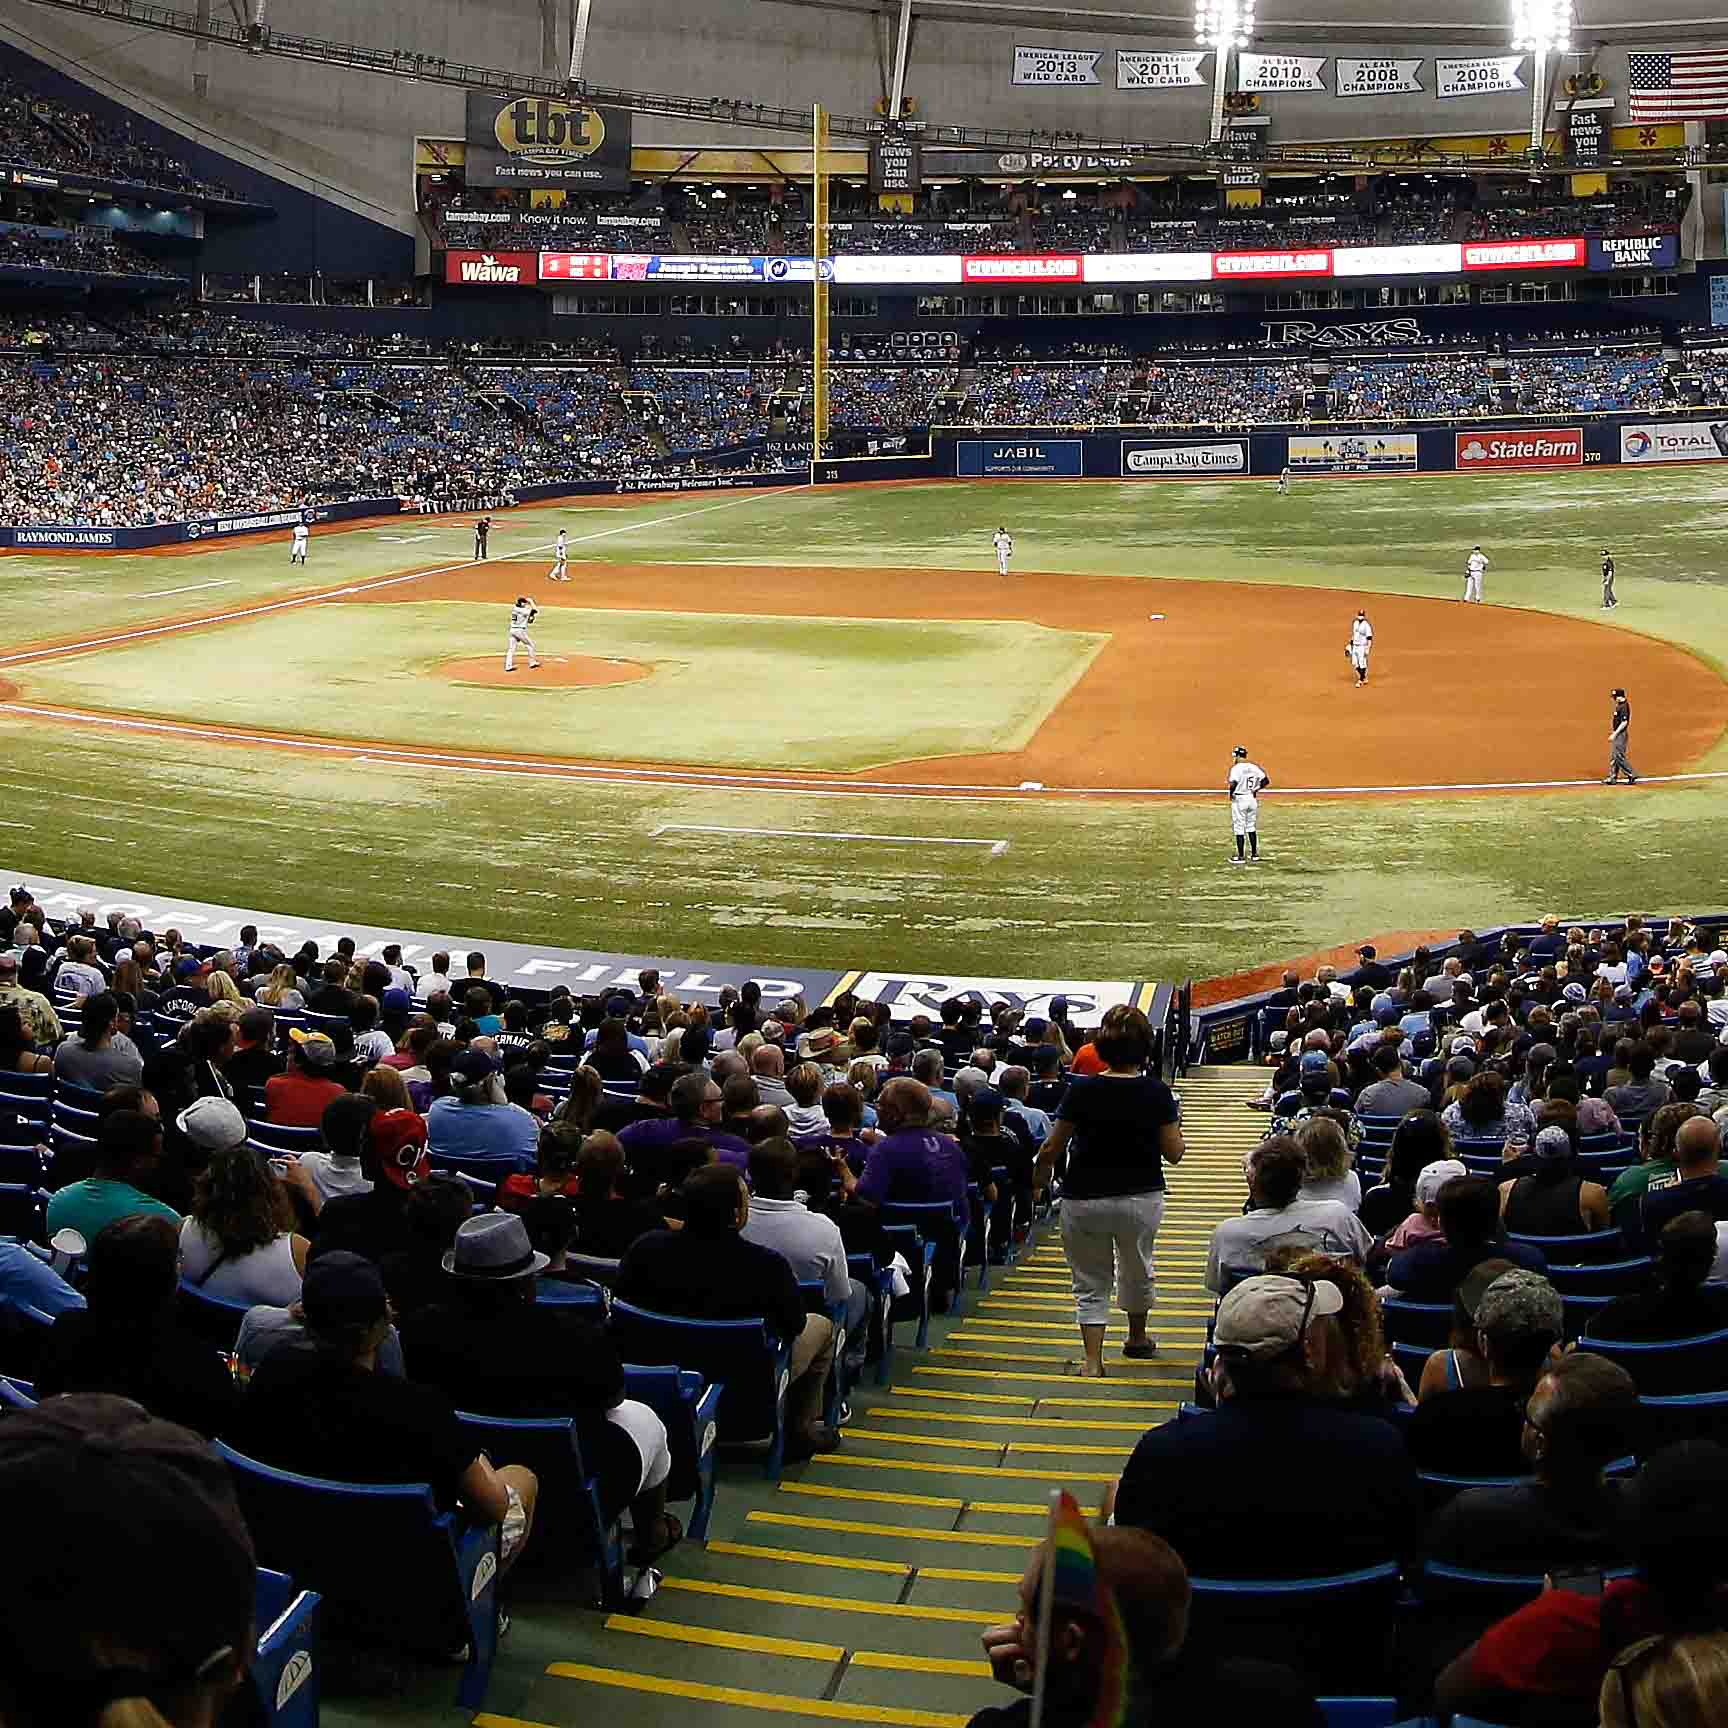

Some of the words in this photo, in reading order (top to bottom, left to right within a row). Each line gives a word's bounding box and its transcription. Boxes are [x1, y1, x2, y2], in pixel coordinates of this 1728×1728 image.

[1036, 60, 1077, 72] 2013
[1140, 63, 1180, 76] 2011
[1023, 72, 1053, 81] WILD
[1056, 74, 1087, 82] CARD
[1259, 66, 1301, 79] 2010
[1356, 69, 1399, 82] 2008
[1456, 68, 1500, 82] 2008
[1127, 76, 1154, 84] WILD
[1160, 75, 1191, 84] CARD
[1245, 79, 1313, 88] CHAMPIONS
[1343, 82, 1410, 92] CHAMPIONS
[1443, 81, 1512, 92] CHAMPIONS
[511, 100, 591, 145] tbt
[1571, 113, 1597, 125] Fast
[1227, 131, 1257, 141] Have
[1570, 125, 1602, 136] news
[1575, 136, 1597, 148] you
[880, 147, 912, 156] news
[885, 158, 907, 169] you
[495, 166, 515, 176] Fast
[518, 168, 542, 177] news
[545, 169, 562, 178] you
[564, 170, 581, 178] can
[584, 171, 602, 179] use.
[885, 167, 907, 177] can
[884, 179, 909, 188] use.
[1223, 173, 1260, 184] buzz?
[446, 211, 510, 223] tampabay.com
[520, 213, 551, 224] Know
[553, 213, 561, 224] it
[564, 215, 588, 225] now.
[597, 215, 660, 227] tampabay.com
[1602, 237, 1662, 251] REPUBLIC
[1614, 249, 1651, 263] BANK
[461, 261, 520, 281] Wawa
[1260, 318, 1420, 347] RAYS
[766, 442, 780, 451] 162
[784, 441, 833, 451] LANDNG
[1655, 434, 1711, 449] TOTAL
[993, 447, 1046, 459] JABIL
[1584, 452, 1600, 462] 370
[1133, 455, 1173, 468] Tampa
[1176, 453, 1199, 468] Bay
[1201, 452, 1238, 465] Times
[625, 479, 636, 489] St.
[638, 479, 679, 490] Petersburg
[681, 478, 717, 488] Welcomes
[17, 532, 74, 544] RAYMOND
[75, 532, 112, 544] JAMES
[872, 978, 1098, 1016] RAYS
